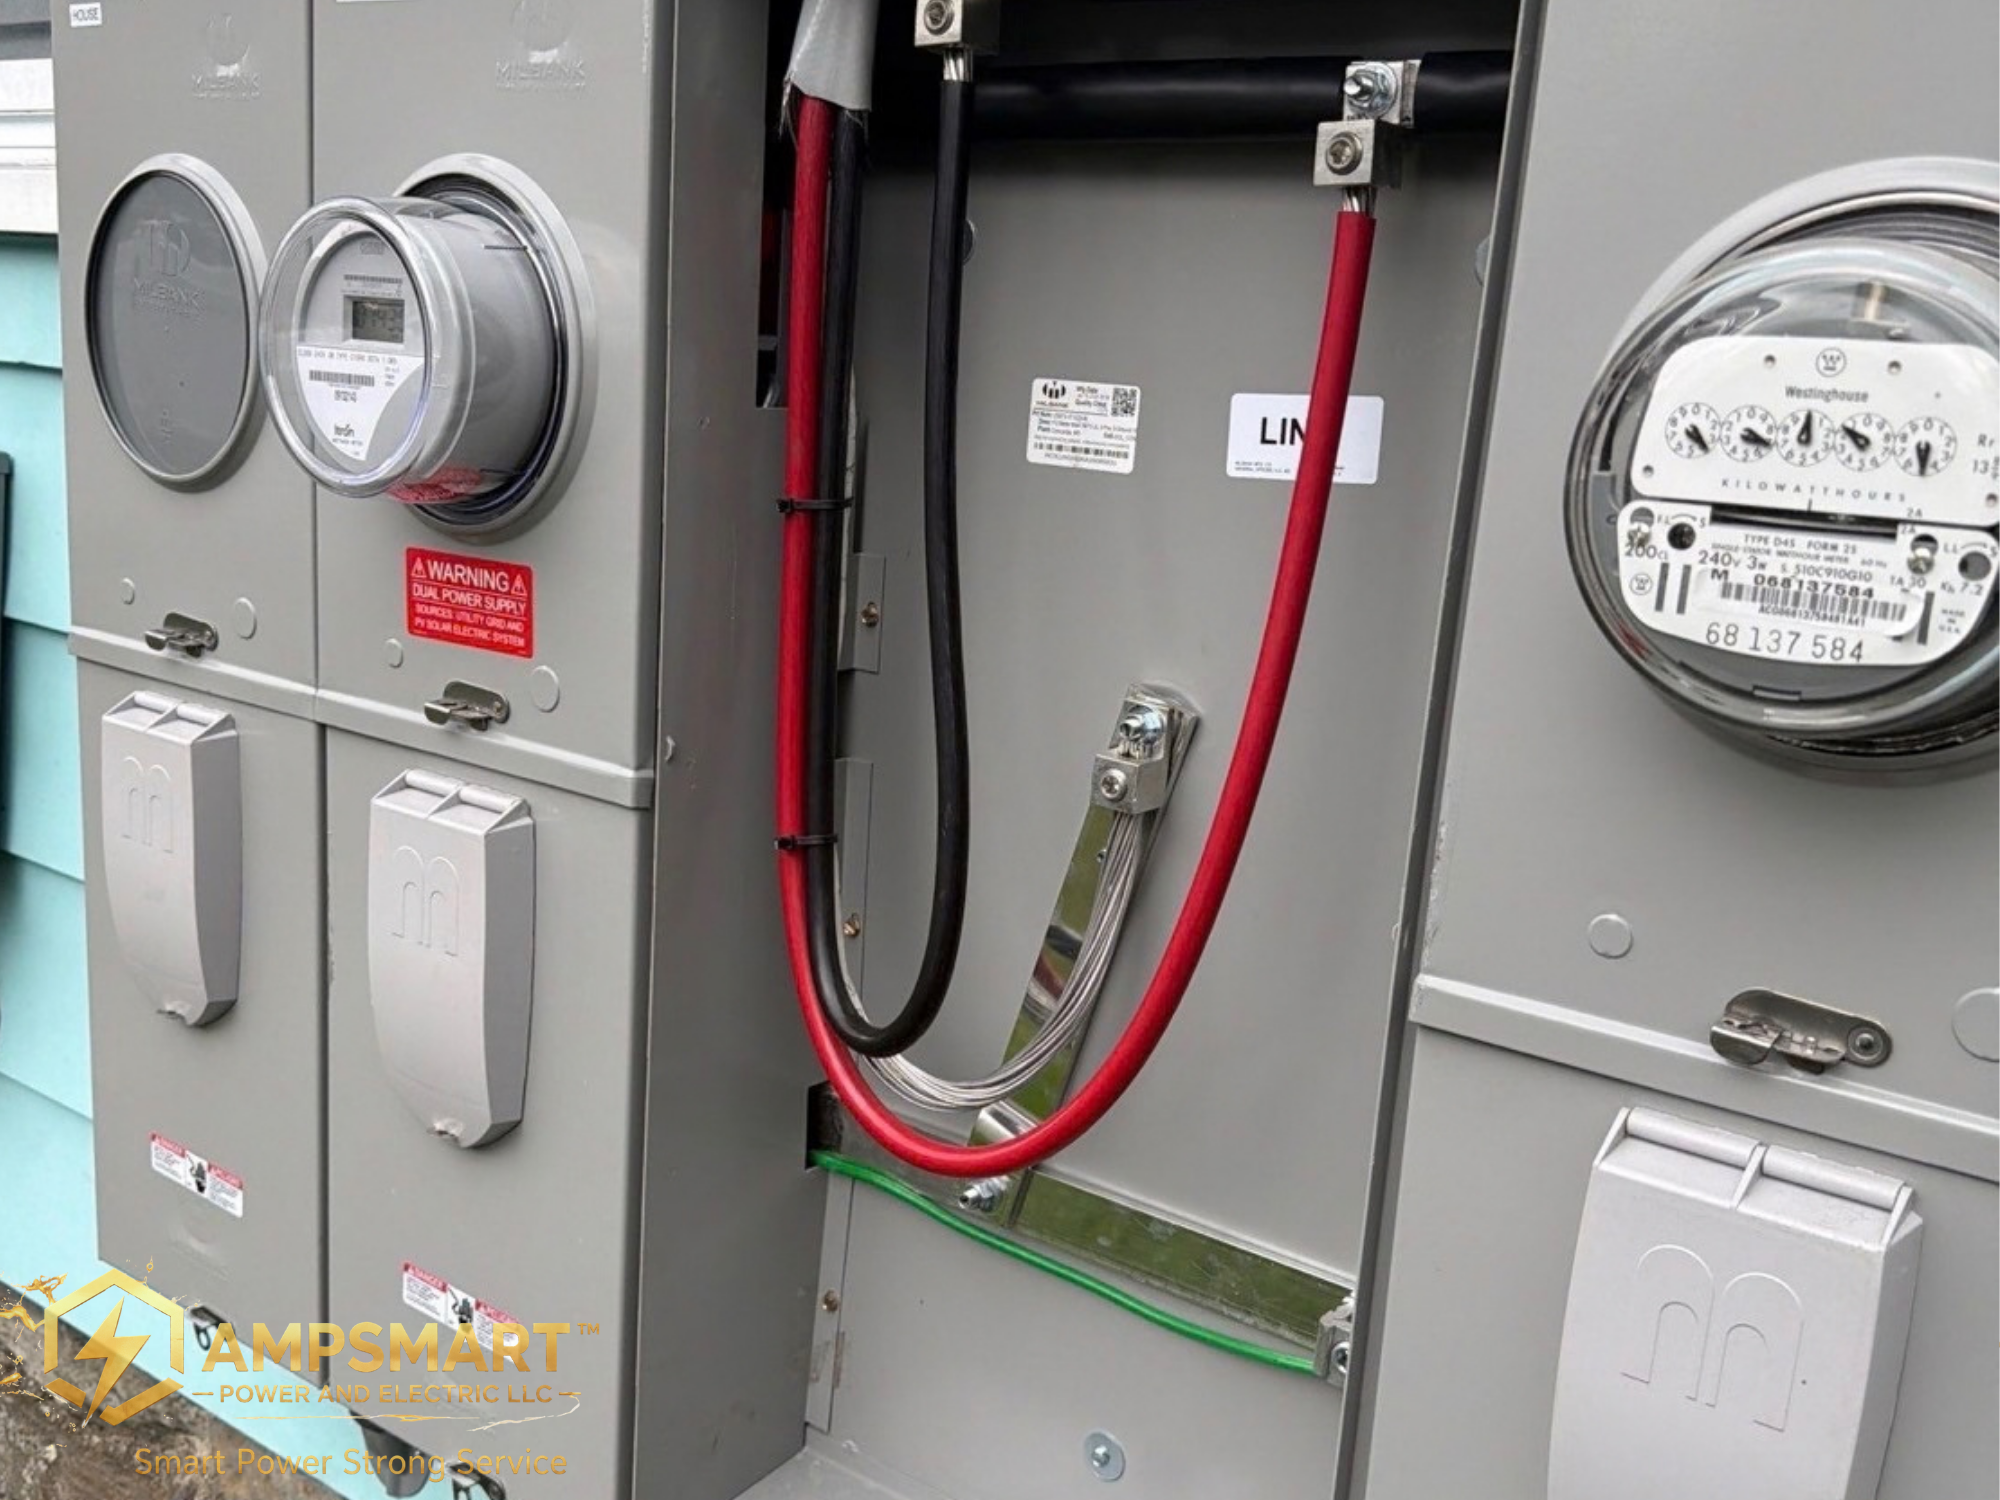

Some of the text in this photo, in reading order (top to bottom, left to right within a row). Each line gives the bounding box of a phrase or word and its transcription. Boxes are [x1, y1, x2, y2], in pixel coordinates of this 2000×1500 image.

[72, 8, 99, 21] HOUSE
[1785, 385, 1869, 403] Westinghouse
[1260, 417, 1305, 445] LIN
[1906, 508, 1923, 518] 2A
[1901, 525, 1916, 535] 2A
[1745, 534, 1769, 545] TYPE
[1807, 540, 1838, 551] FORM
[427, 559, 510, 592] WARNING
[1711, 568, 1874, 598] M 068137584
[413, 582, 526, 616] DUAL POWER SUPPLY
[426, 618, 452, 631] SOLAR
[453, 624, 491, 640] ELECTRIC
[492, 632, 525, 646] SYSTEM
[507, 621, 524, 632] AND
[1706, 622, 1863, 662] 68 137 584
